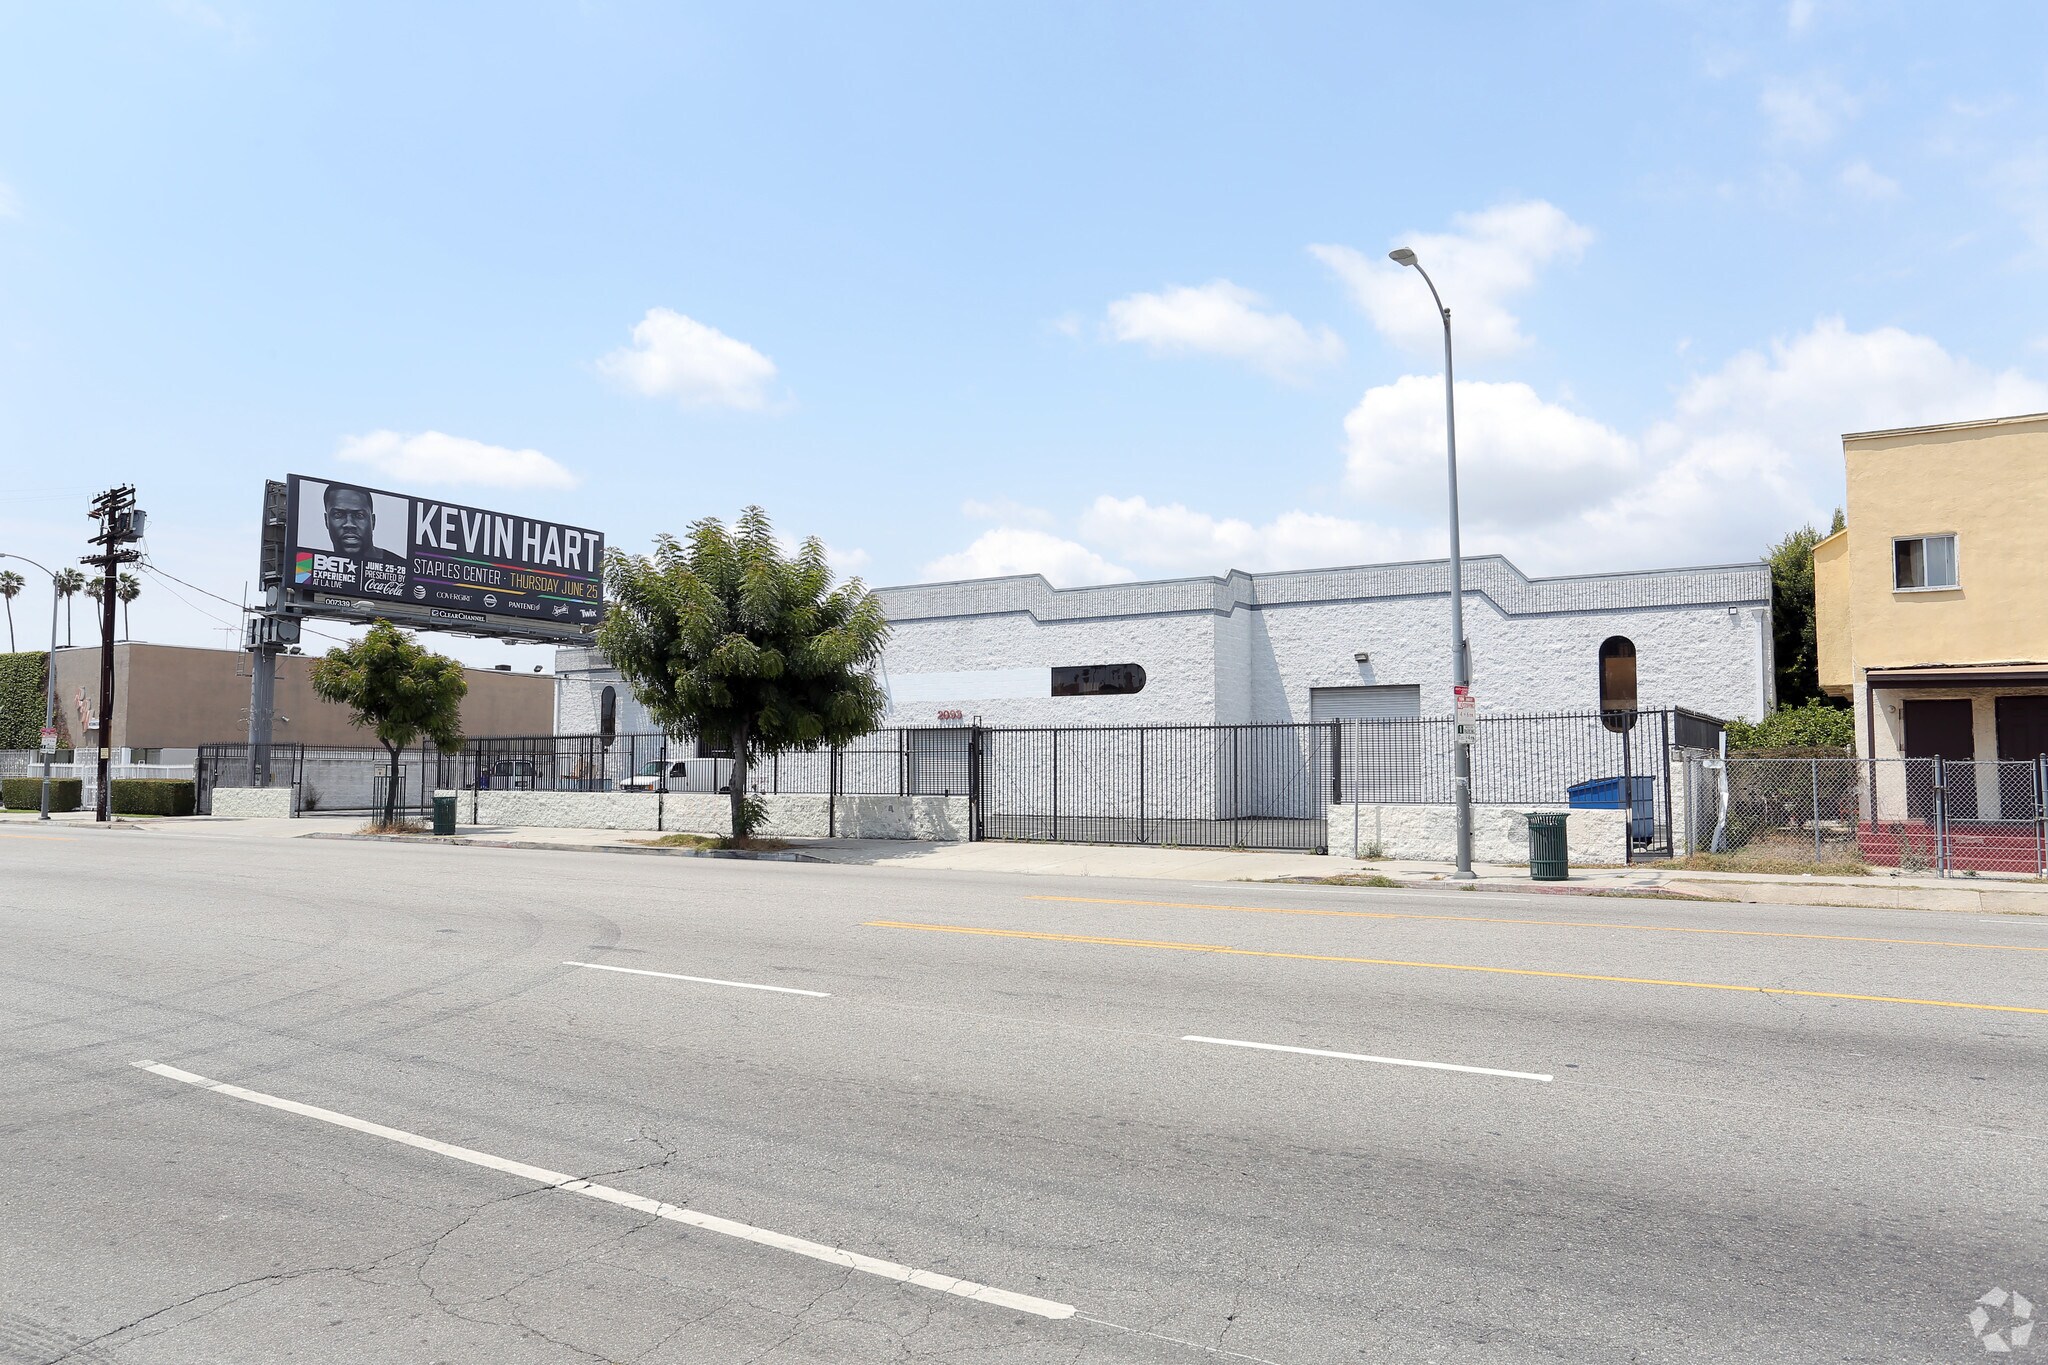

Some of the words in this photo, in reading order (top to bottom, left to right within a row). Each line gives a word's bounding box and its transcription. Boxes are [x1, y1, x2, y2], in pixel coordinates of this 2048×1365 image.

[415, 501, 514, 560] KEVIN
[522, 521, 600, 573] HART
[313, 553, 351, 573] BET
[365, 561, 384, 572] JUNE
[385, 564, 406, 575] 25-28
[312, 570, 356, 583] EXPERIENCE
[364, 570, 397, 582] PRESENTED
[398, 574, 406, 583] BY
[413, 558, 460, 580] STAPLES
[463, 565, 501, 585] CENTER
[510, 572, 559, 593] THURSDAY
[561, 581, 584, 597] JUNE
[586, 584, 598, 599] 25
[331, 581, 343, 589] LIVE
[364, 578, 405, 597] Coca-Cola
